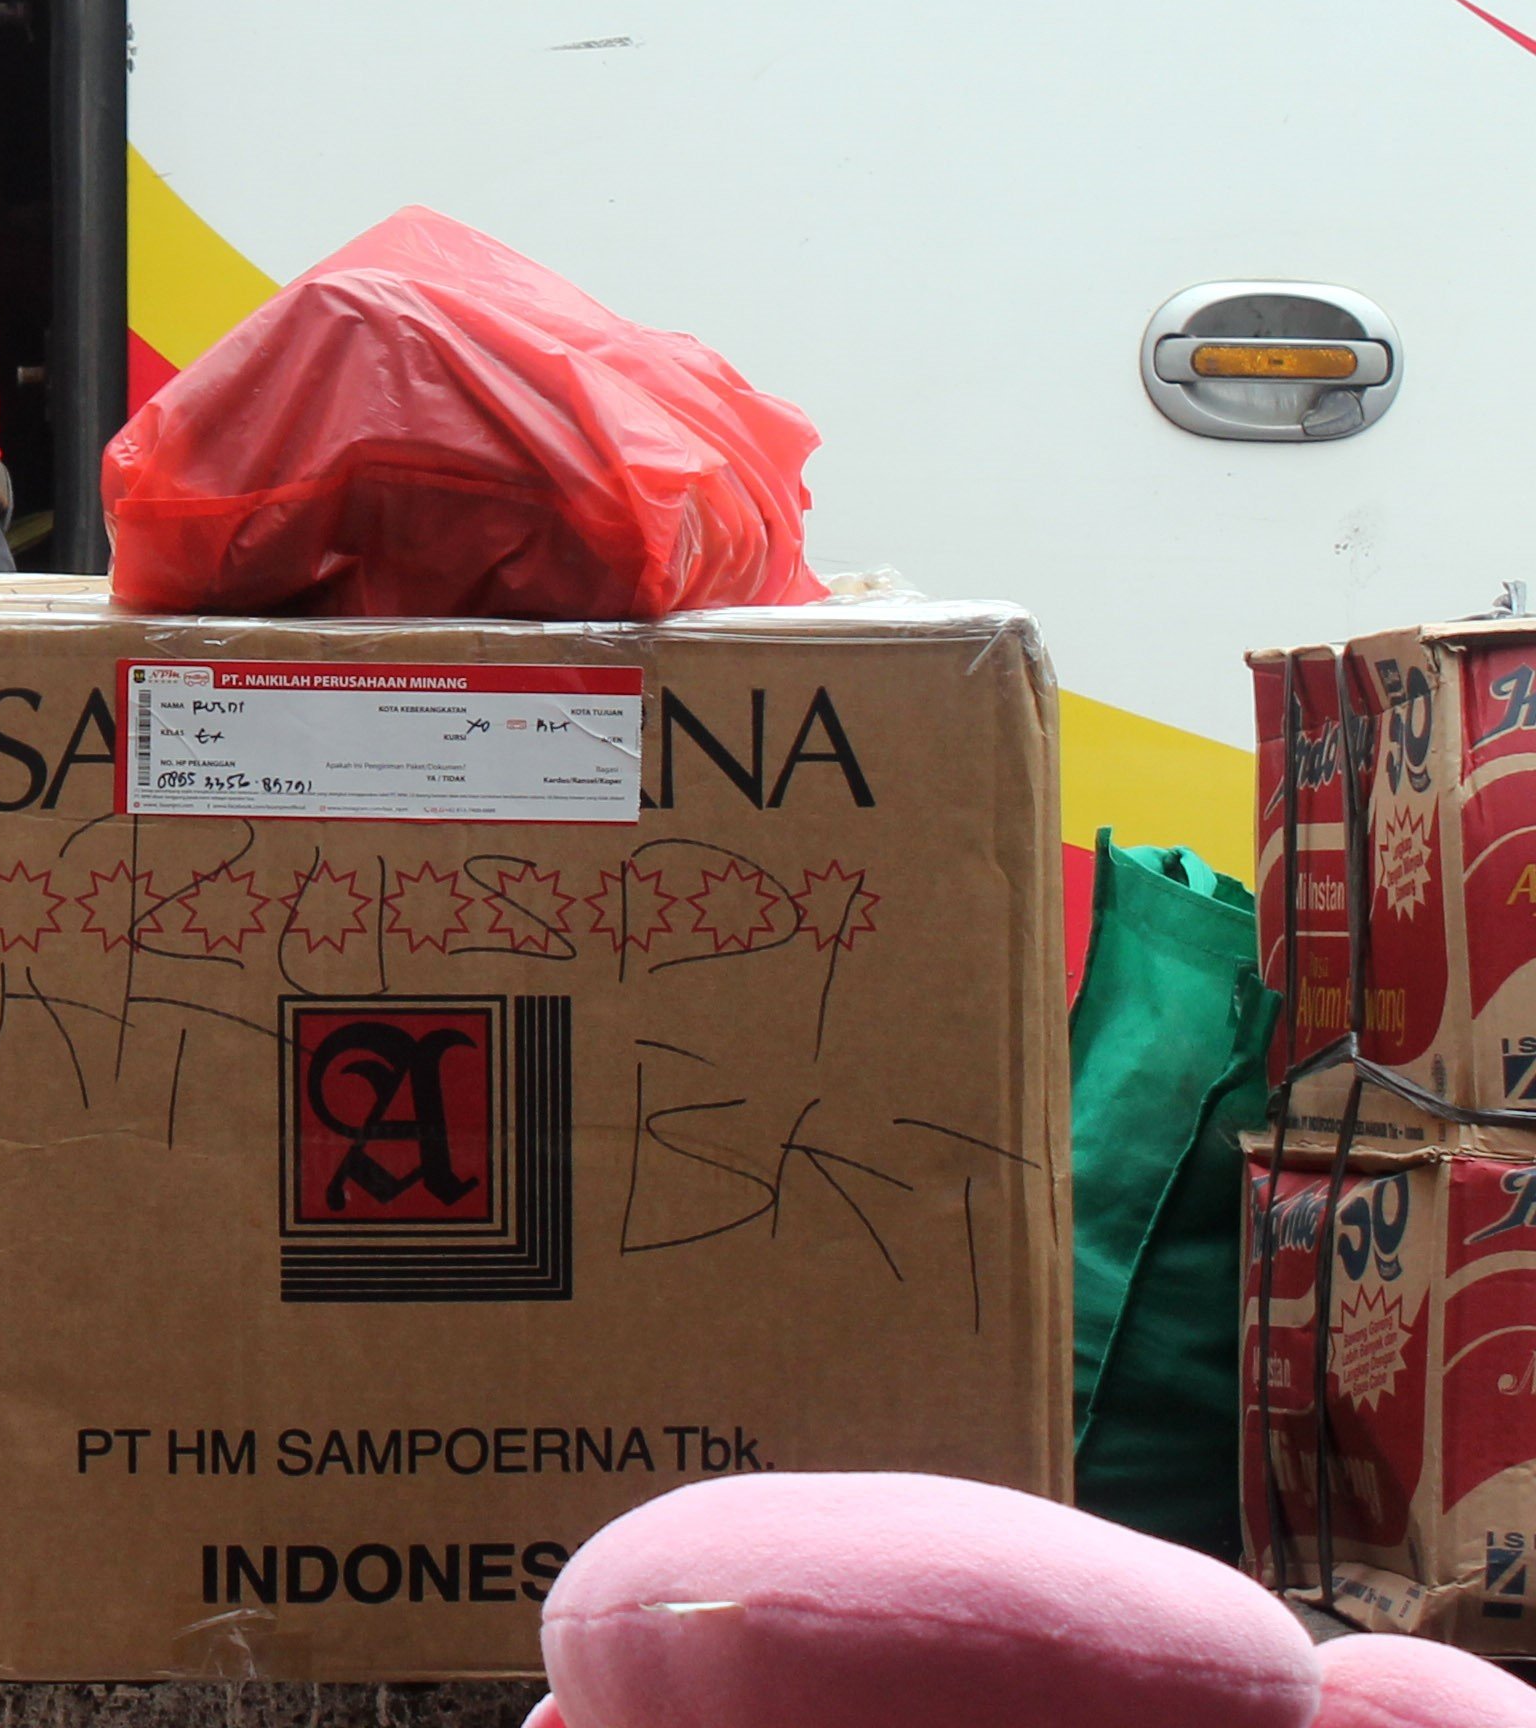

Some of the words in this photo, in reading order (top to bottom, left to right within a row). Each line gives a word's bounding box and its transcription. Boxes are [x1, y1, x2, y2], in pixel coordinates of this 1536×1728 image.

[221, 674, 242, 686] PT.
[245, 674, 311, 687] NAIKILAH
[313, 675, 407, 688] PERUSAHAAN
[409, 677, 468, 689] MINANG
[400, 706, 467, 714] KEBERANGKATAN
[592, 709, 623, 717] TUJUAN
[77, 1428, 151, 1474] PT
[168, 1428, 257, 1474] HM
[277, 1426, 655, 1475] SAMPOERNA
[663, 1425, 776, 1472] Tbk.
[201, 1542, 583, 1604] INDONES
